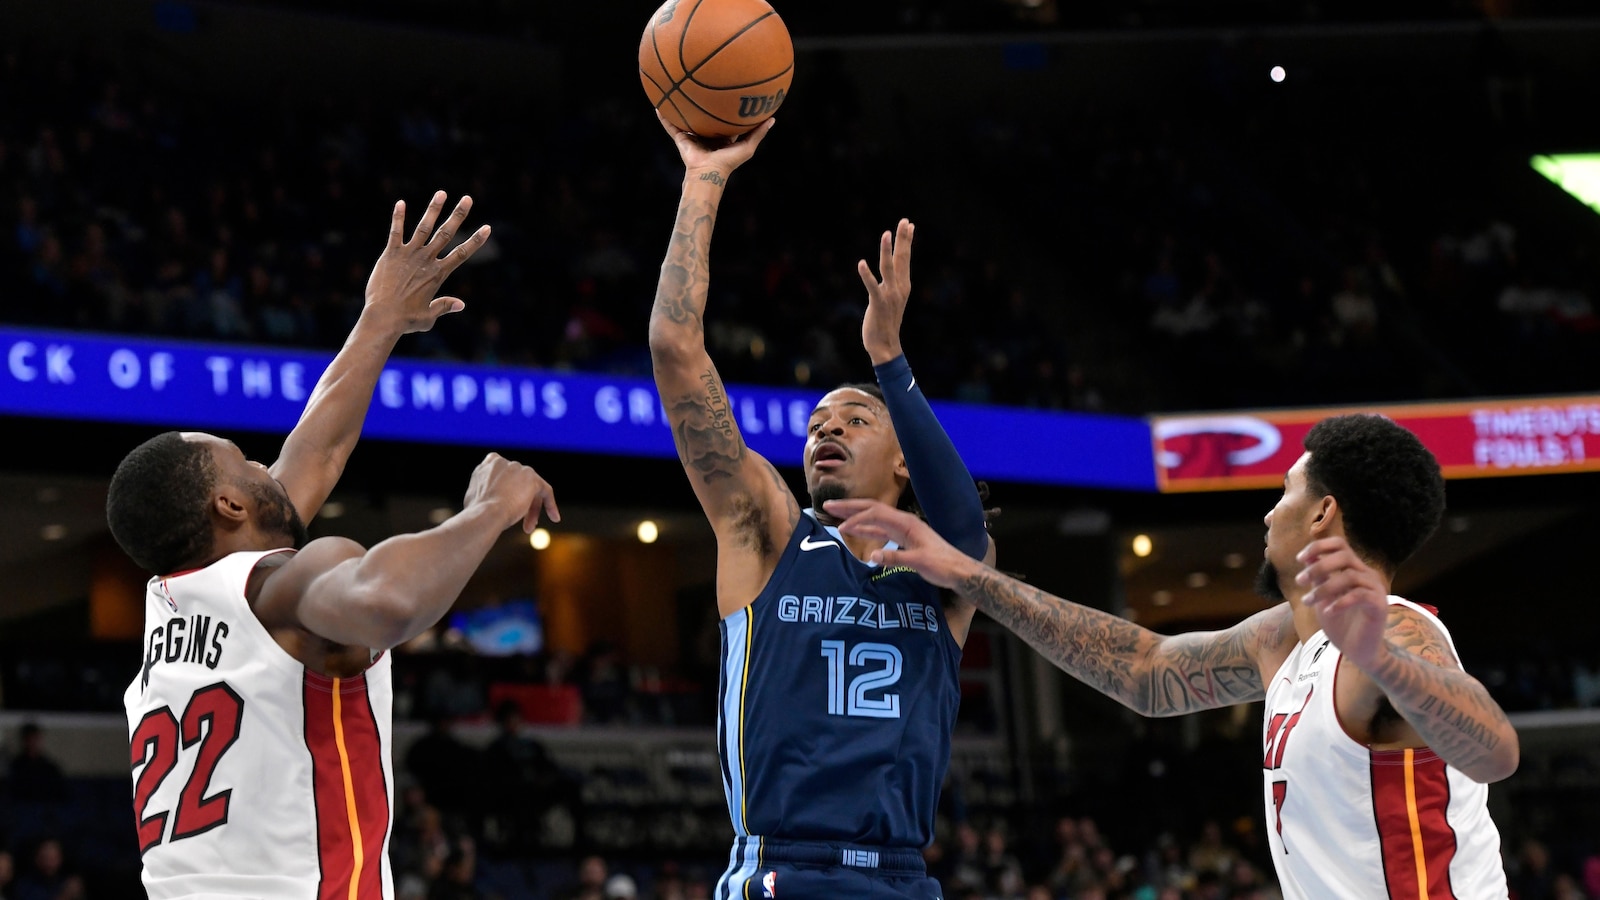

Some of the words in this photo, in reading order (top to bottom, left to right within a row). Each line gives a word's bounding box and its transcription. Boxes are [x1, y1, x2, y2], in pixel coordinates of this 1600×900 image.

[738, 88, 788, 118] Wil
[107, 348, 176, 391] OF
[205, 356, 307, 402] THE
[379, 369, 568, 419] EMPHIS
[777, 594, 940, 634] GRIZZLIES
[140, 614, 230, 697] GGINS
[820, 639, 904, 720] 12
[130, 680, 245, 857] 22
